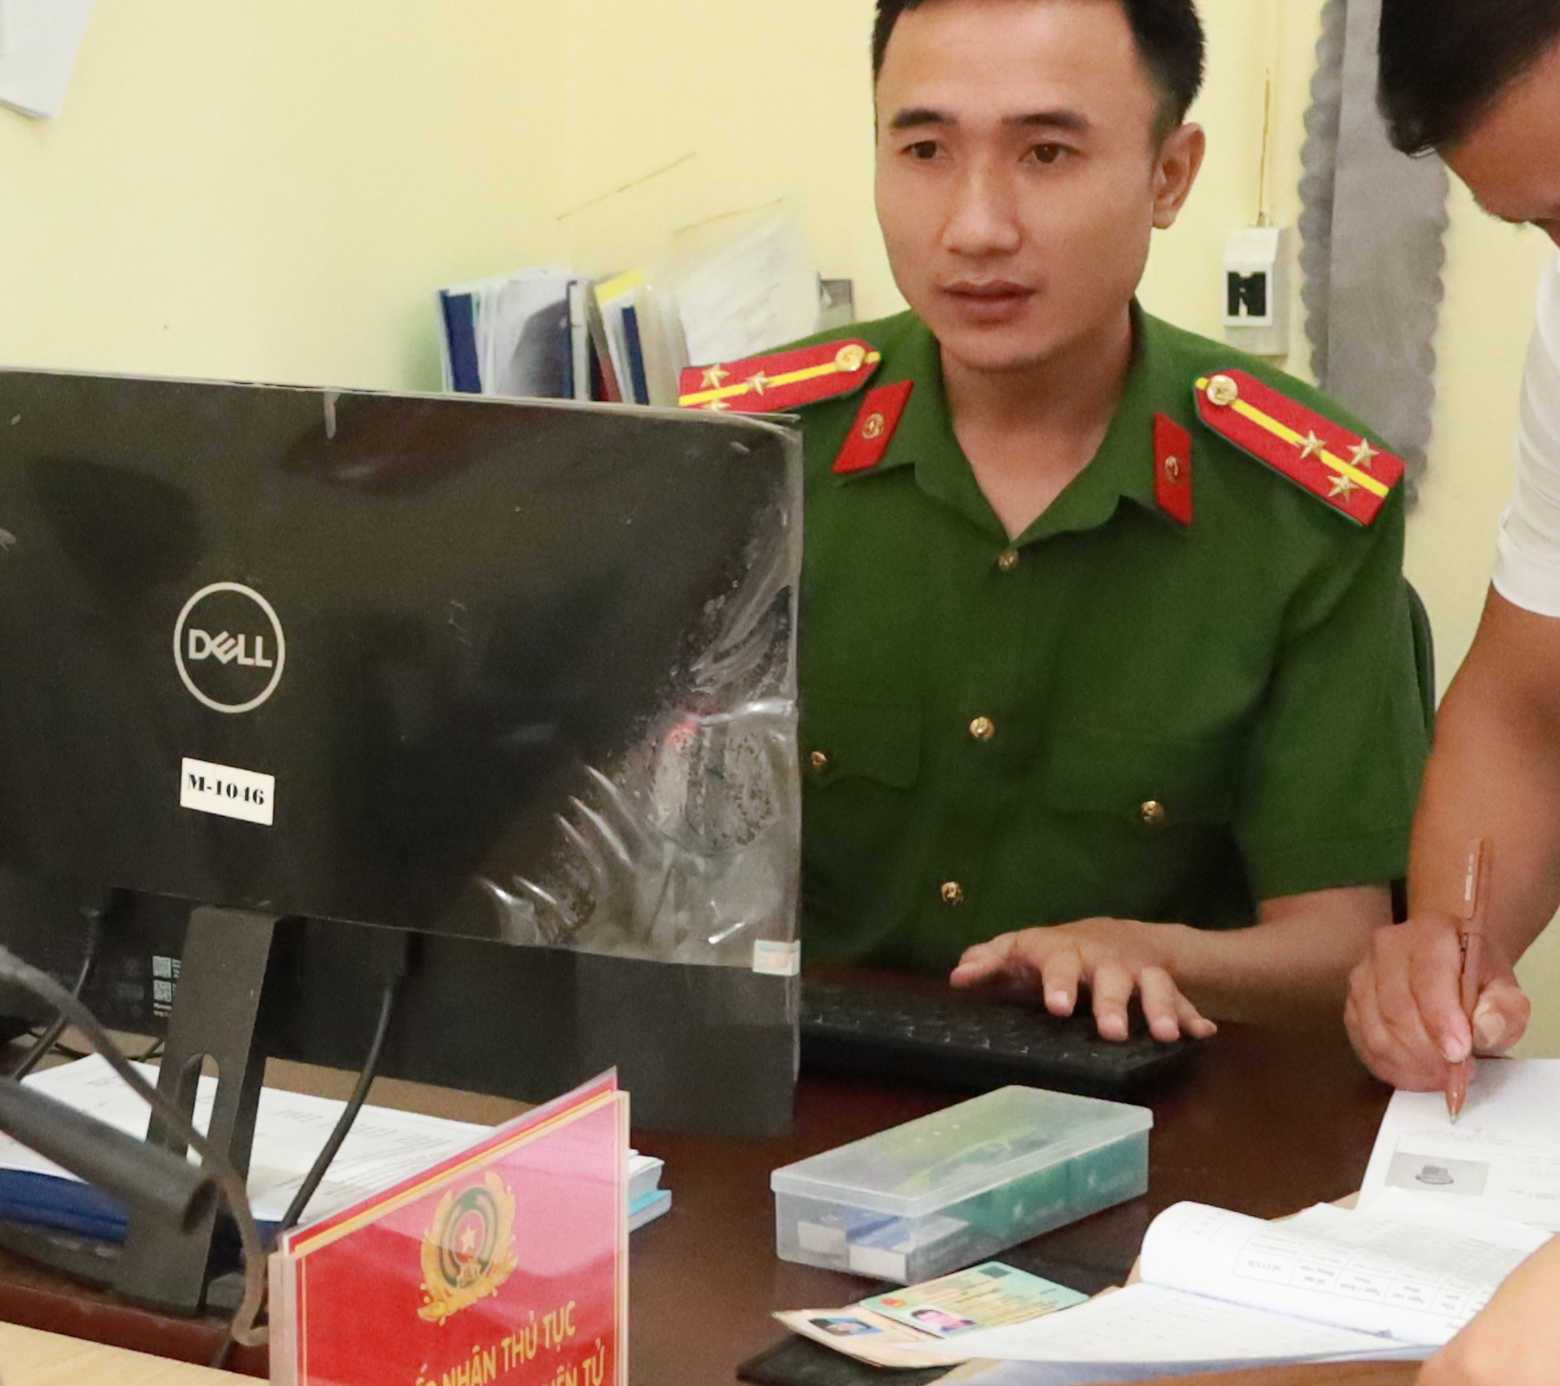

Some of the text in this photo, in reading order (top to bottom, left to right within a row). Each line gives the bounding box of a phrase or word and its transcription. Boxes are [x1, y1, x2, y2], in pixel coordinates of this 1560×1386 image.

[188, 628, 273, 668] DELL
[187, 773, 266, 806] M-1046
[501, 1310, 538, 1372] THỦ
[542, 1300, 577, 1352] TỤC
